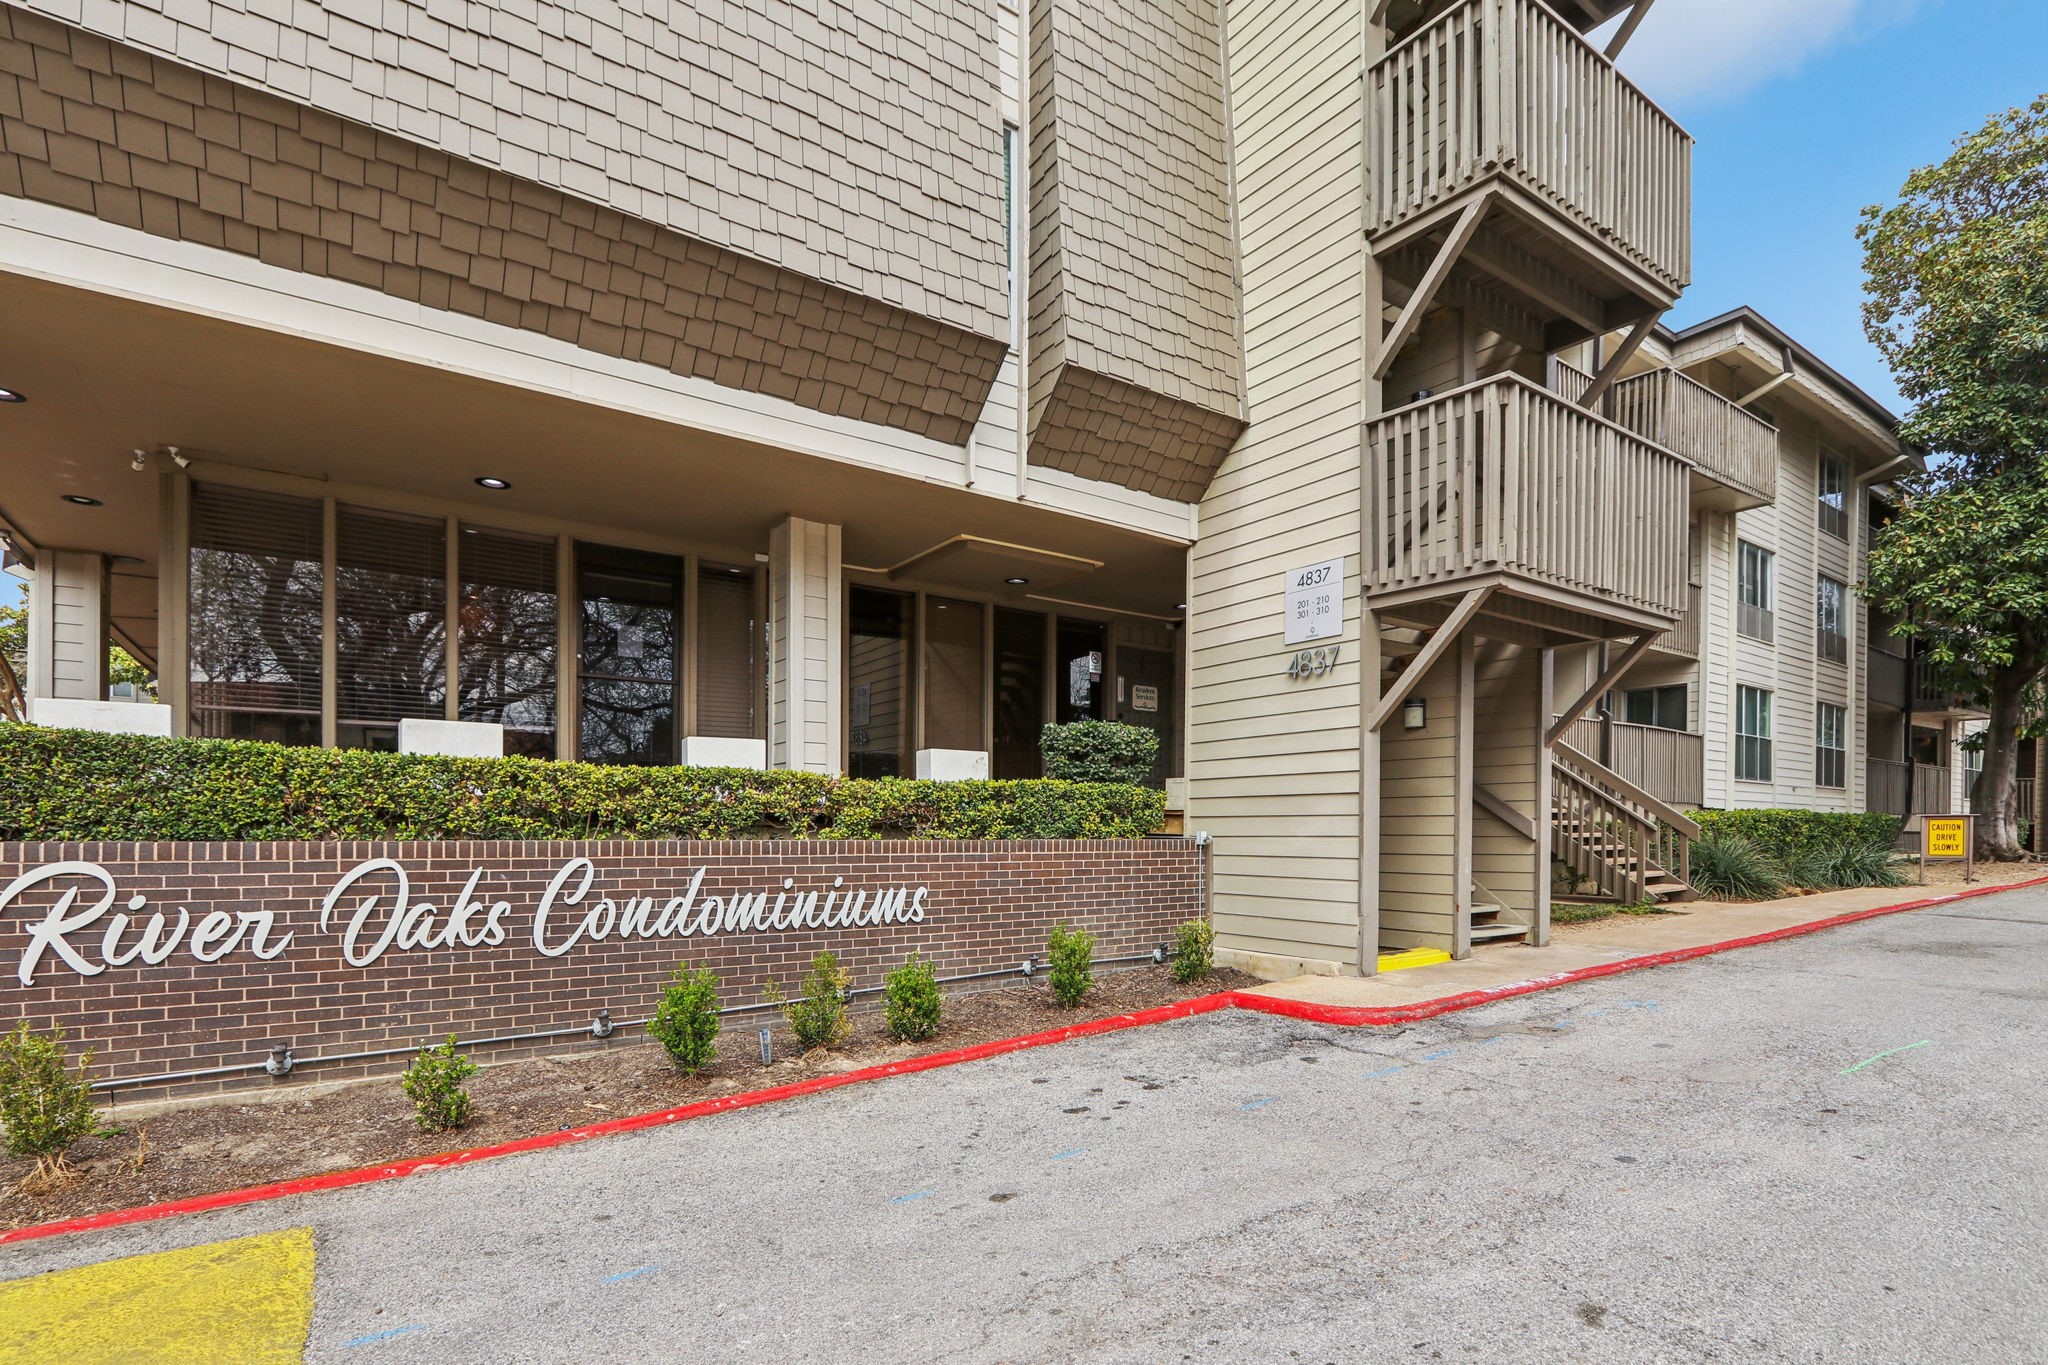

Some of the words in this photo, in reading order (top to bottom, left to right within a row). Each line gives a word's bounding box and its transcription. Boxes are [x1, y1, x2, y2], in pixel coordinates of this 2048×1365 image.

[1297, 567, 1331, 587] 4837
[1297, 600, 1309, 609] 201
[1317, 595, 1330, 605] 210
[1297, 610, 1309, 619] 301
[1317, 605, 1330, 616] 310
[1288, 645, 1340, 679] 4837
[0, 860, 294, 986] River
[321, 857, 511, 967] Oaks
[533, 856, 928, 957] Condominiums
